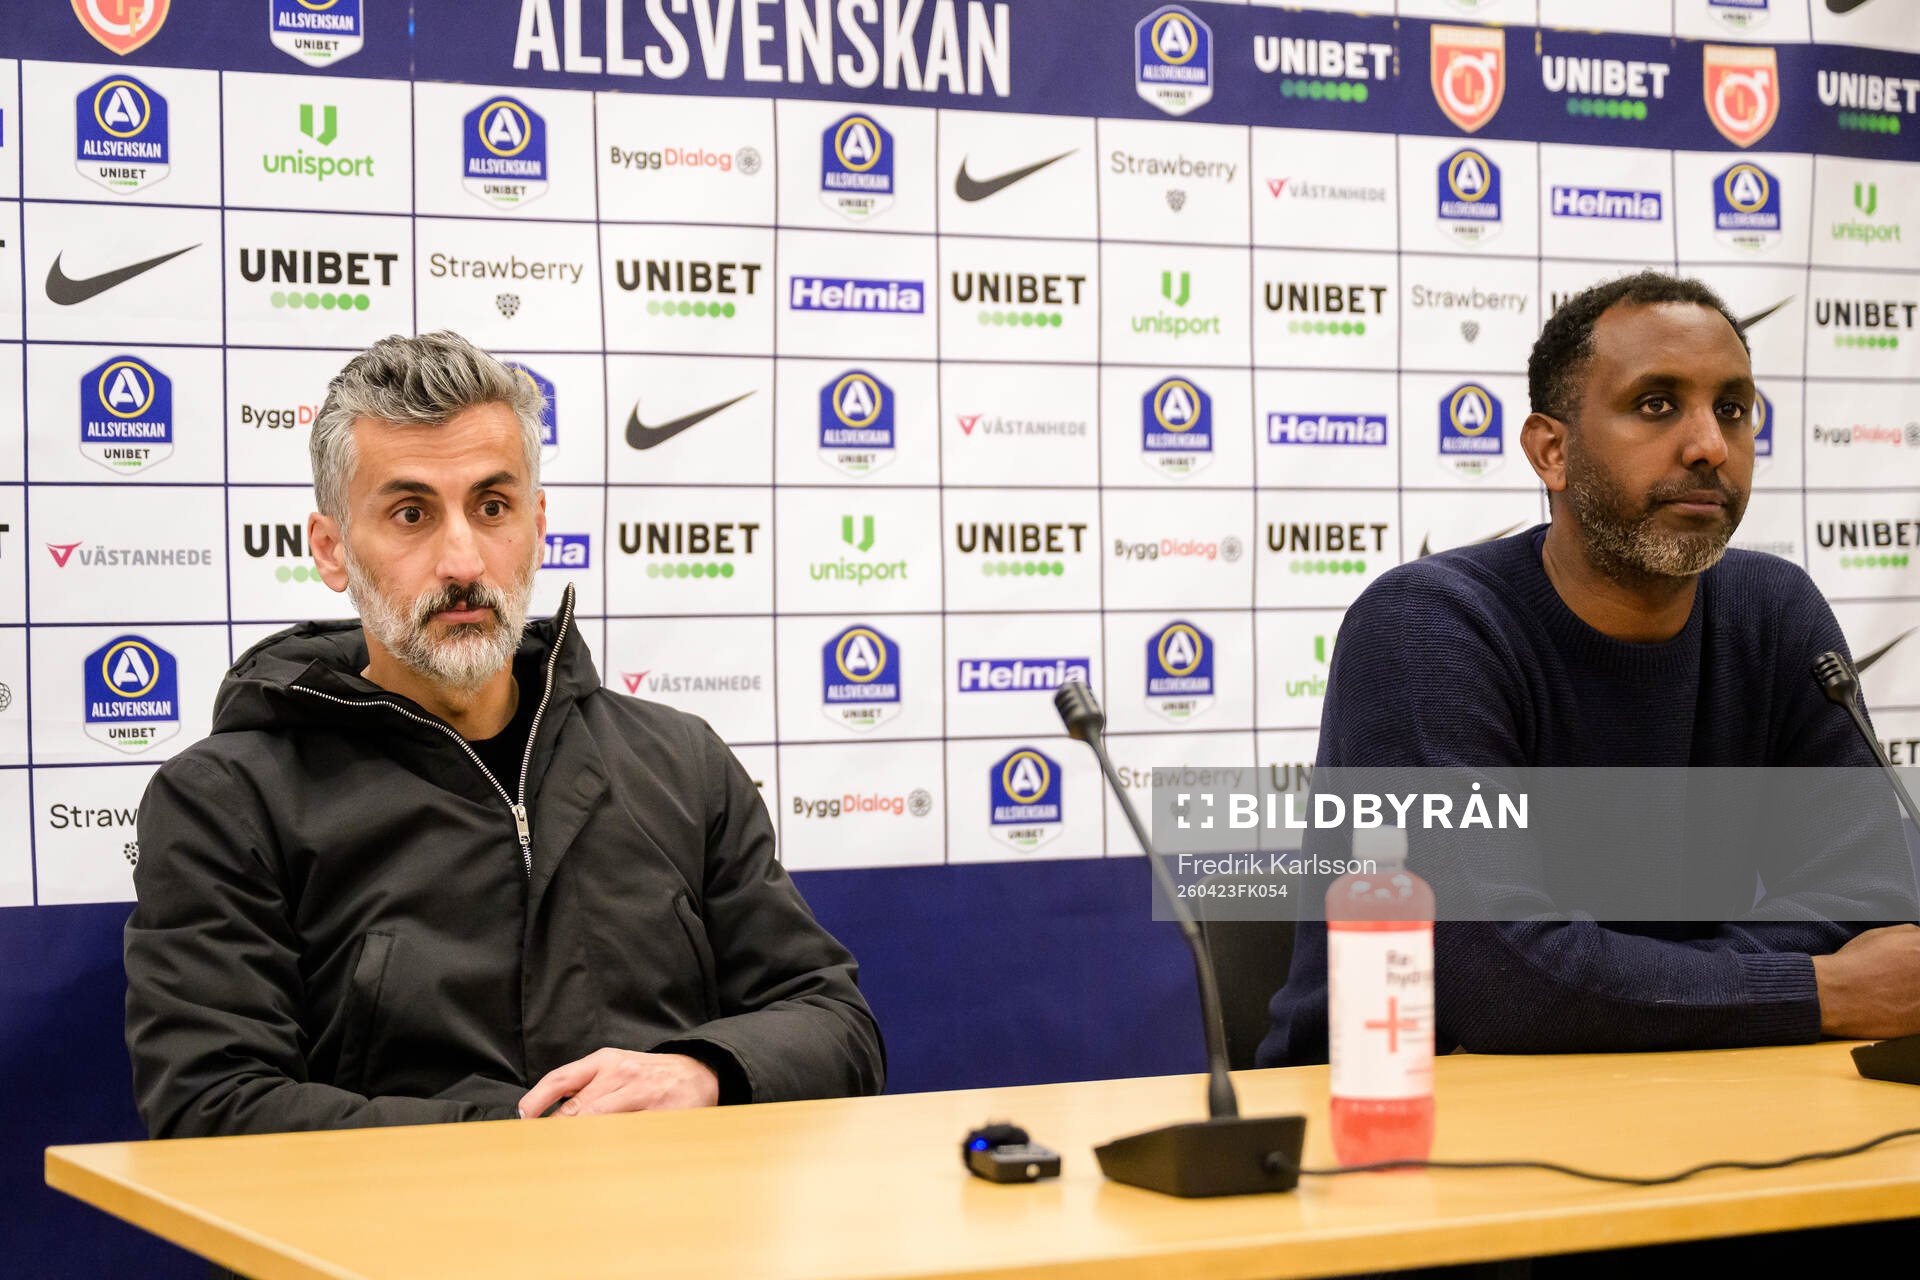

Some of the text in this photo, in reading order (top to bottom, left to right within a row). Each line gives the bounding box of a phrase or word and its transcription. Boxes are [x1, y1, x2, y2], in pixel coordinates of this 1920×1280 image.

[278, 11, 354, 31] ALLSVENSKAN
[294, 39, 339, 51] UNIBET
[513, 0, 1010, 97] ALLSVENSKAN
[1254, 36, 1391, 80] UNIBET
[1542, 55, 1670, 99] UNIBET
[1817, 70, 1920, 114] UNIBET
[83, 140, 161, 159] ALLSVENSKAN
[610, 146, 732, 171] ByggDialog
[100, 167, 146, 180] UNIBET
[263, 149, 375, 181] unisport
[469, 158, 541, 177] ALLSVENSKAN
[1111, 151, 1236, 182] Strawberry
[484, 185, 527, 196] UNIBET
[1553, 189, 1660, 219] Helmia
[241, 249, 398, 286] UNIBET
[430, 253, 584, 283] Strawberry
[616, 260, 761, 294] UNIBET
[792, 279, 921, 312] Helmia
[952, 272, 1086, 304] UNIBET
[1265, 284, 1387, 315] UNIBET
[1412, 285, 1528, 313] Strawberry
[1131, 312, 1221, 338] unisport
[1815, 302, 1917, 328] UNIBET
[88, 421, 166, 438] ALLSVENSKAN
[982, 417, 1087, 437] VÄSTANHEDE
[1270, 417, 1384, 443] Helmia
[104, 449, 151, 460] UNIBET
[619, 522, 760, 555] UNIBET
[956, 523, 1087, 553] UNIBET
[1114, 538, 1217, 560] ByggDialog
[1267, 524, 1388, 552] UNIBET
[79, 546, 211, 566] VÄSTANHEDE
[809, 559, 908, 587] unisport
[648, 673, 761, 692] VÄSTANHEDE
[92, 701, 172, 717] ALLSVENSKAN
[108, 727, 156, 739] UNIBET
[1117, 765, 1244, 790] Strawberry
[793, 795, 905, 818] ByggDialog
